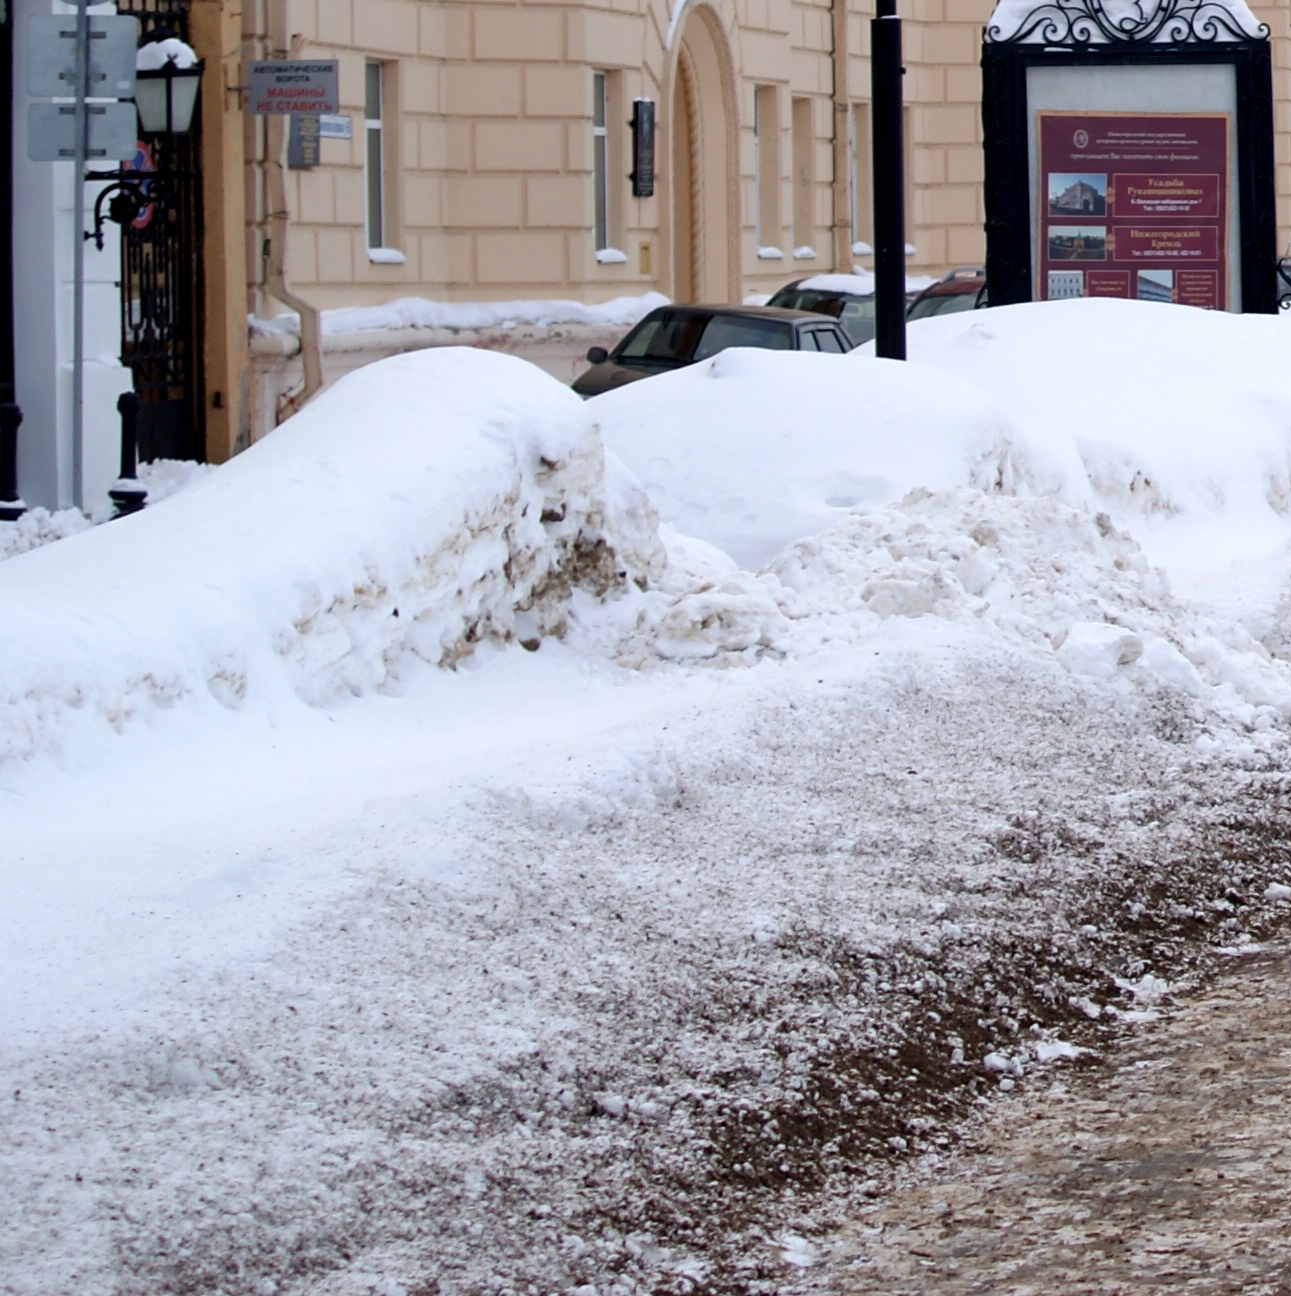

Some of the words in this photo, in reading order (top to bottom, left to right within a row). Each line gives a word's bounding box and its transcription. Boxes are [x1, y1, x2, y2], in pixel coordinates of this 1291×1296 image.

[254, 65, 333, 73] АВТОМАТИЧЕСКИЕ
[267, 88, 325, 97] МАШИНЫ
[256, 101, 273, 111] НЕ
[276, 102, 332, 111] СТАВИТЬ
[1147, 178, 1184, 187] Усадьба
[1130, 229, 1201, 239] Нижегородский
[1151, 239, 1182, 250] Кремль
